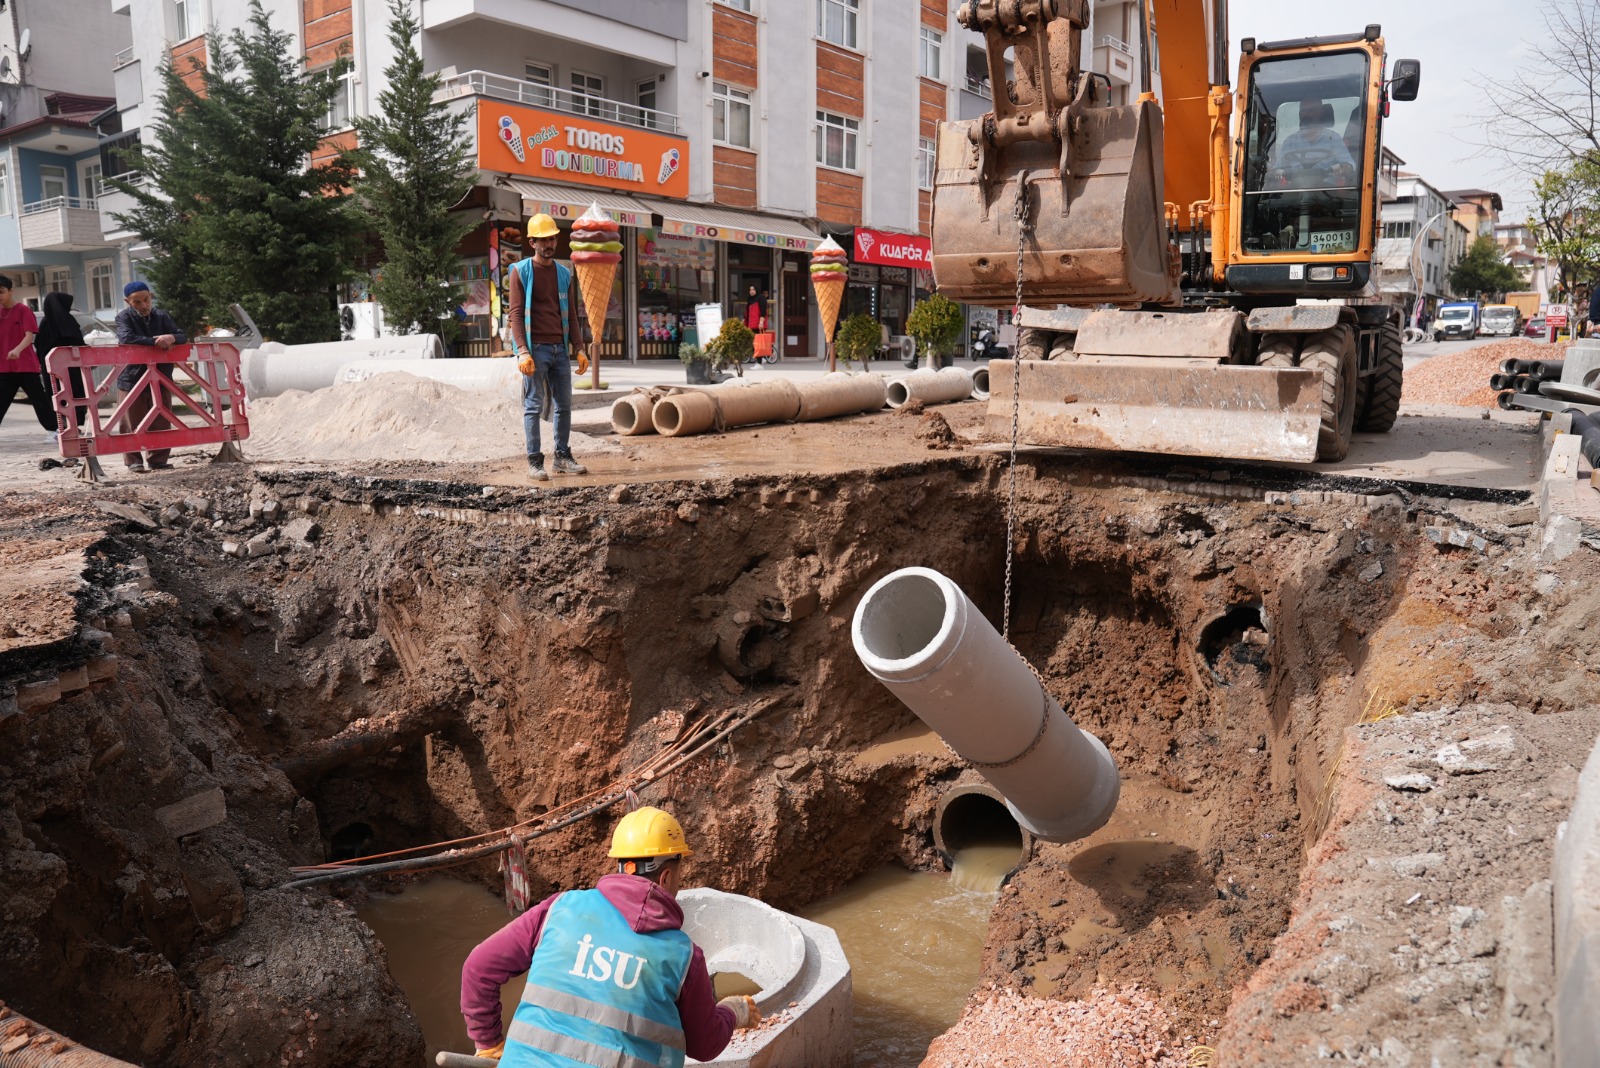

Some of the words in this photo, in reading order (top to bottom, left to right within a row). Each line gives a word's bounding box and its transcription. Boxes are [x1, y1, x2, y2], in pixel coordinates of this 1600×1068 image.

[564, 126, 625, 155] TOROS
[541, 148, 645, 183] DONDURMA
[671, 221, 729, 239] TOROS
[734, 232, 815, 250] DONDURMA
[1313, 232, 1351, 243] 340013
[879, 243, 923, 261] KUAFÖR
